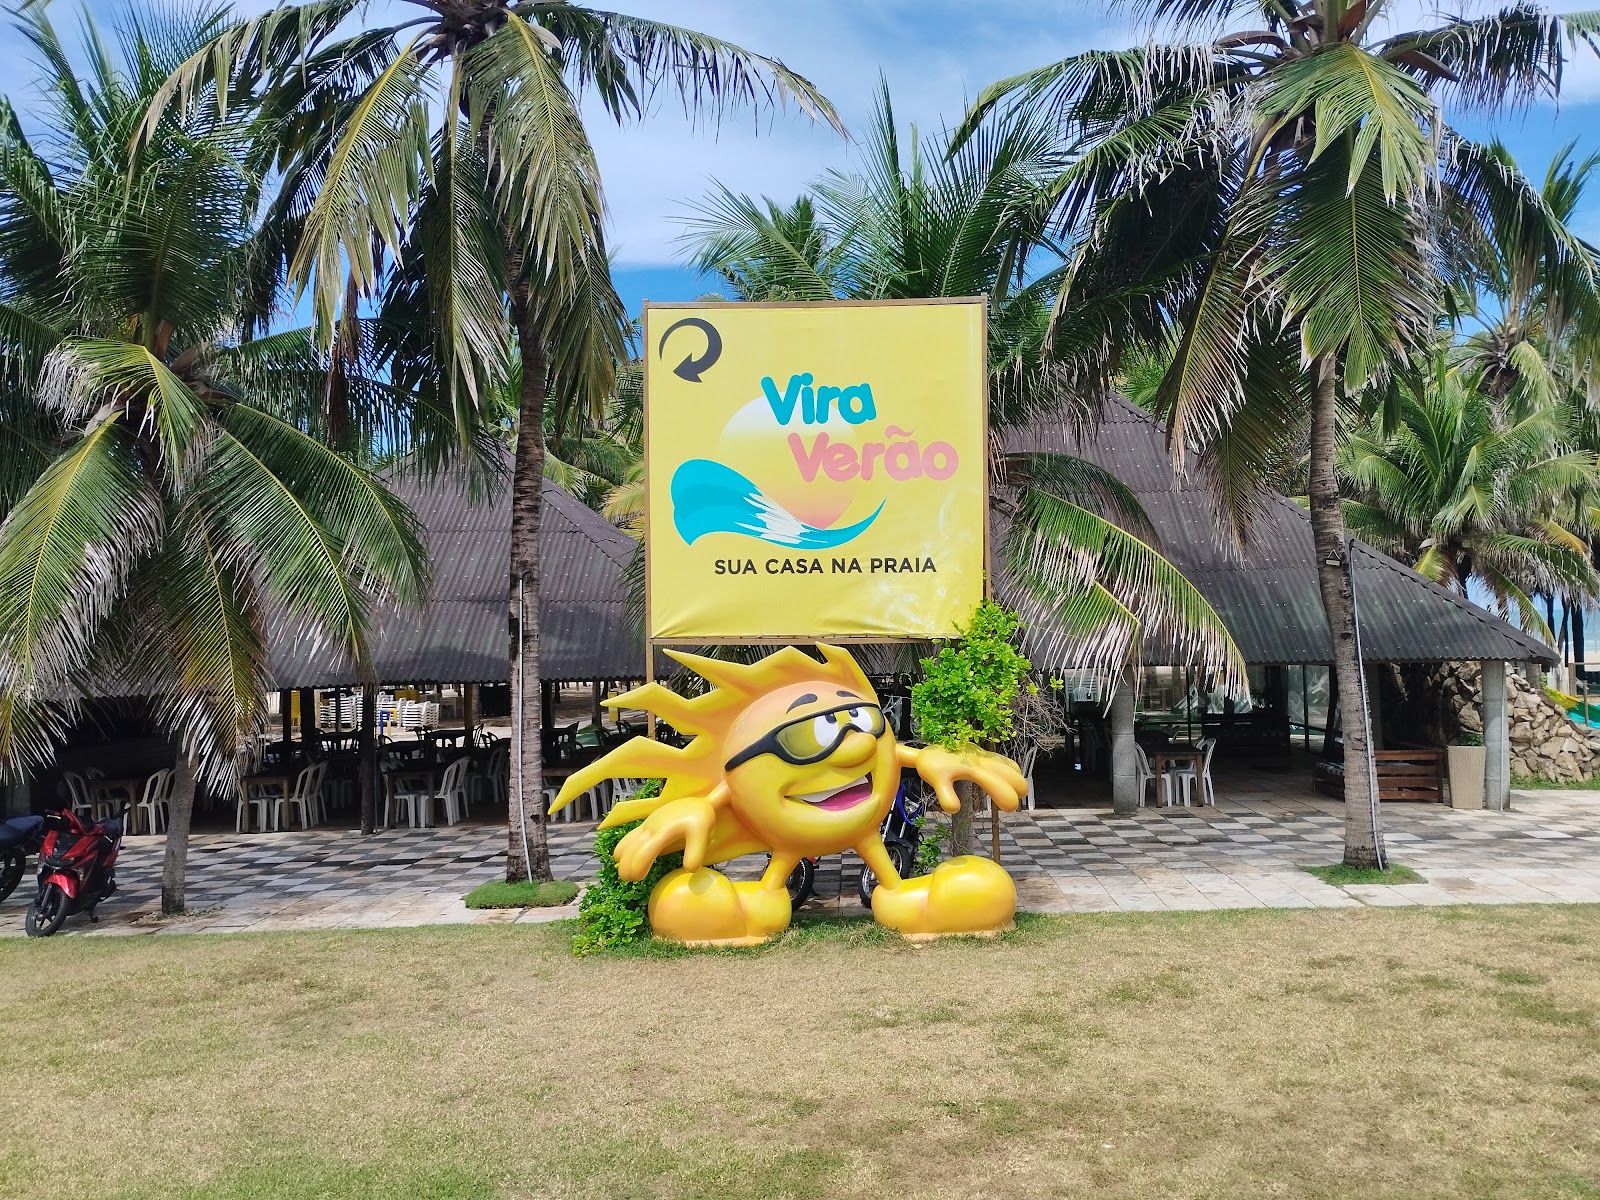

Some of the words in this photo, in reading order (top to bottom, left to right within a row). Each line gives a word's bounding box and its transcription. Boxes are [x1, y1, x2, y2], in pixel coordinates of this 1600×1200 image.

[760, 372, 877, 426] Vira
[787, 425, 959, 483] Verão
[714, 558, 758, 575] SUA
[765, 558, 824, 574] CASA
[832, 558, 863, 574] NA
[870, 557, 937, 574] PRAIA
